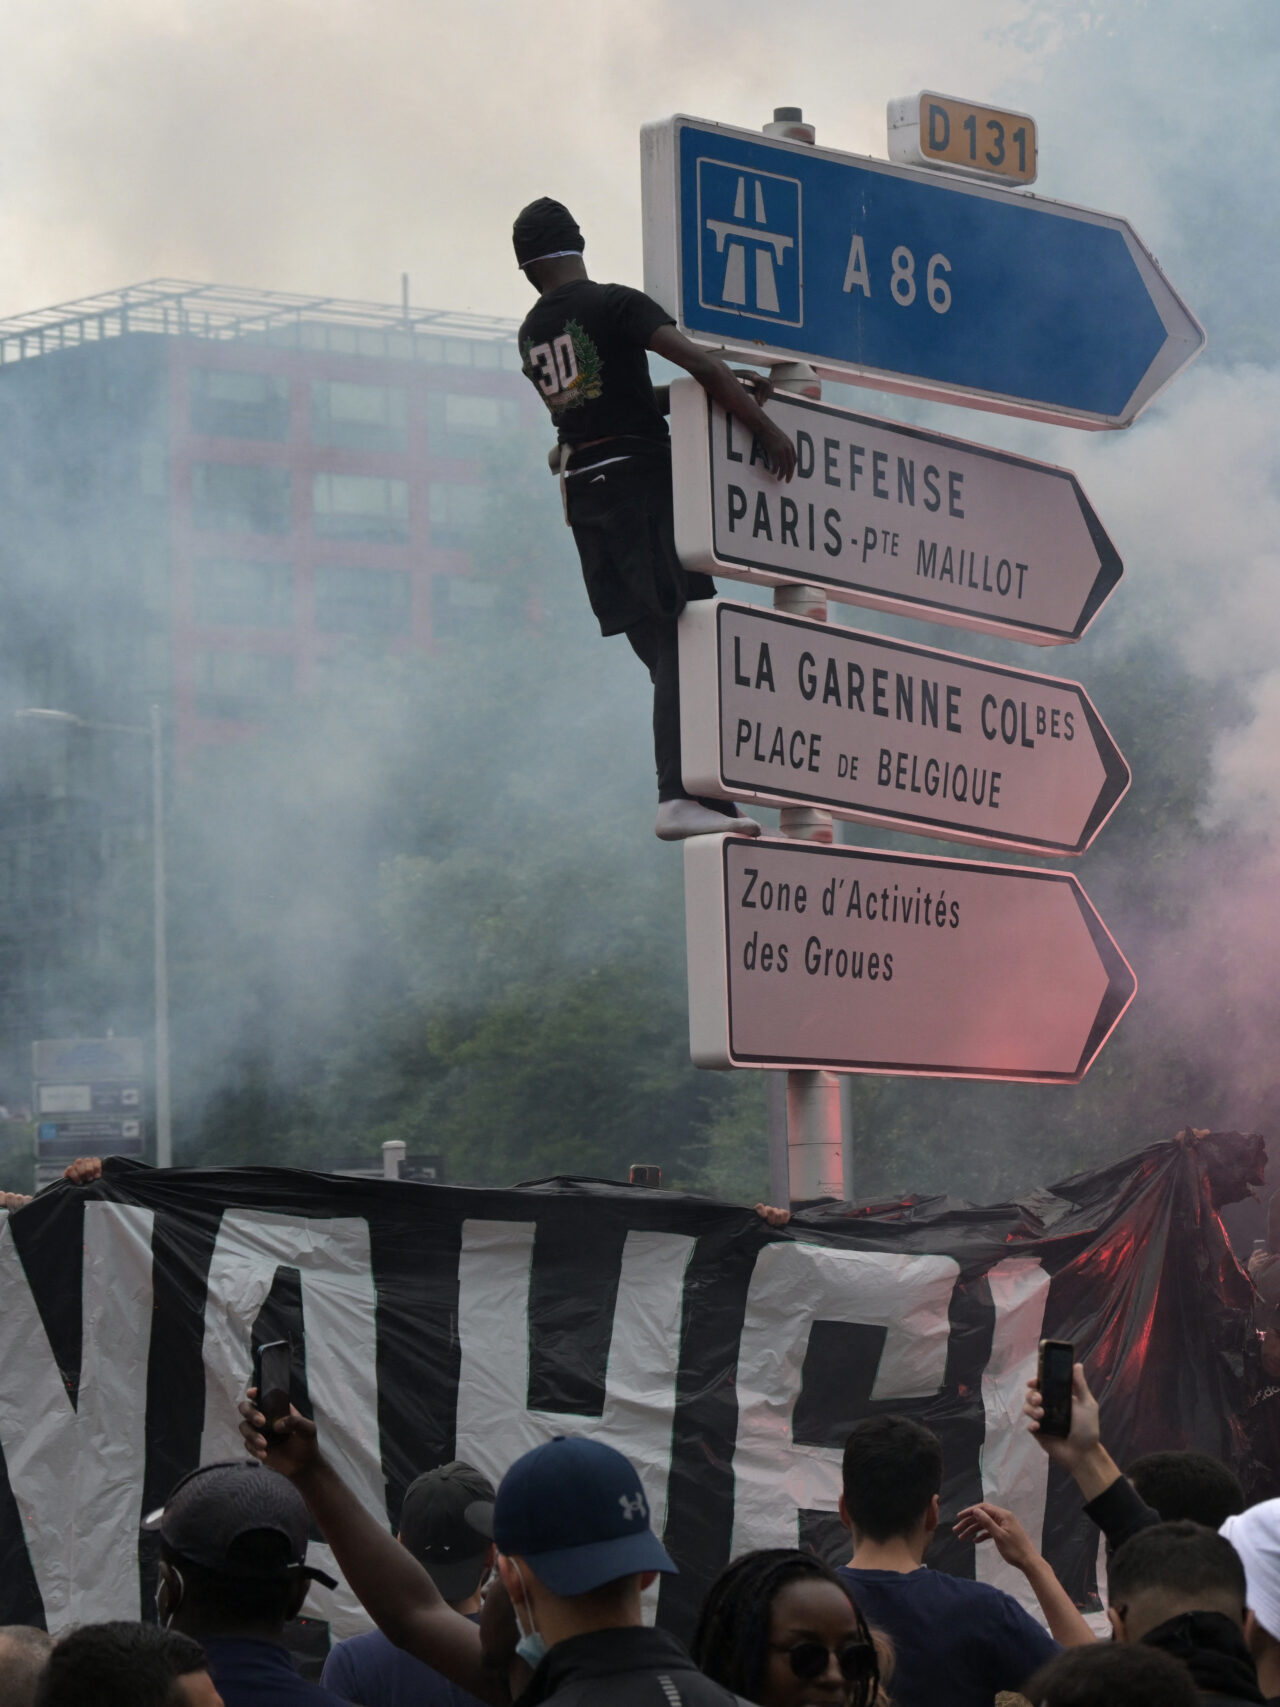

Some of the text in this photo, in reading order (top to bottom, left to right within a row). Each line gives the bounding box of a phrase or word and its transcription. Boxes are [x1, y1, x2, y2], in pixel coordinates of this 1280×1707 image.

[927, 103, 1027, 172] D 131
[842, 234, 953, 314] A 86
[529, 333, 578, 396] 30
[796, 429, 965, 519] DEFENSE
[916, 539, 1028, 599] MAILLOT
[733, 635, 776, 693] LA
[799, 651, 963, 734] GARENNE
[735, 718, 1002, 809] PLACE DE BELGIQUE
[741, 868, 961, 928] Zone d'Activités
[743, 931, 895, 982] des Groues
